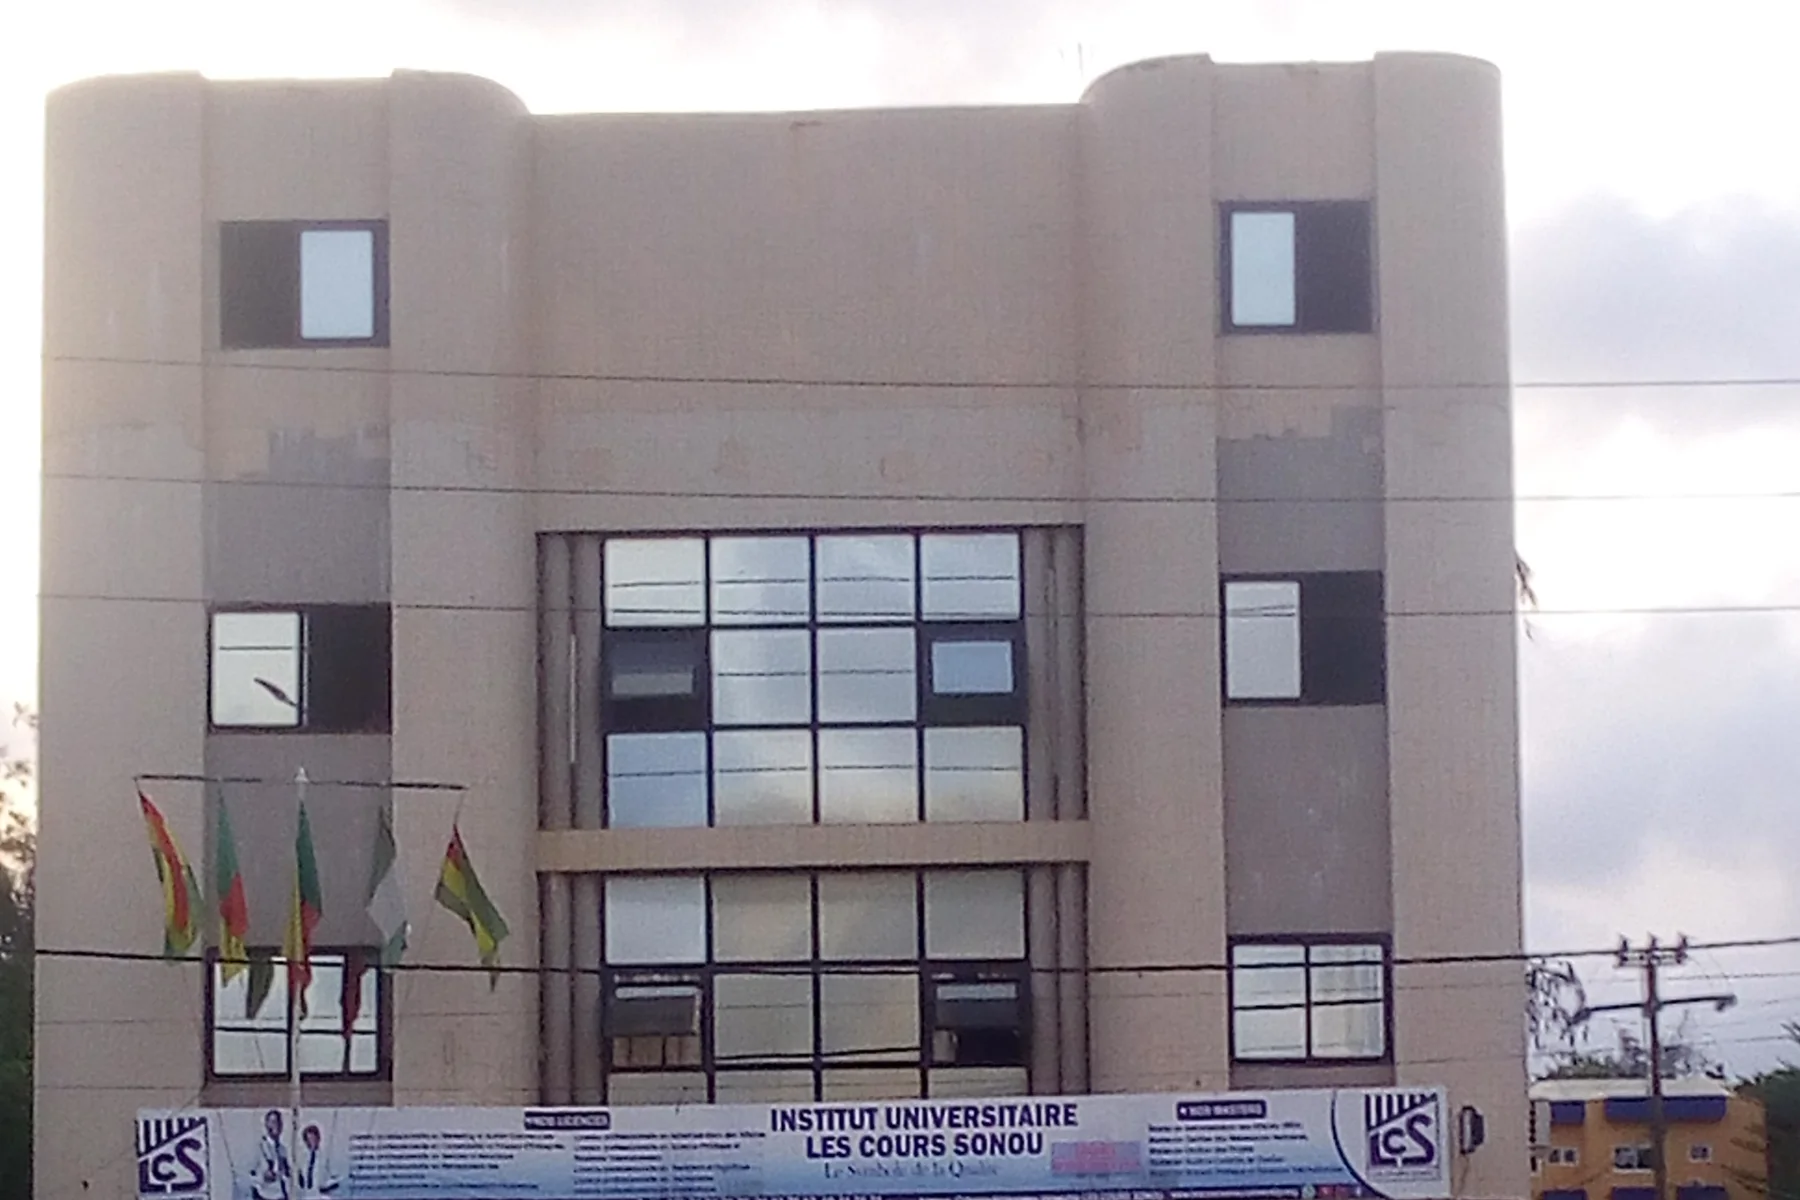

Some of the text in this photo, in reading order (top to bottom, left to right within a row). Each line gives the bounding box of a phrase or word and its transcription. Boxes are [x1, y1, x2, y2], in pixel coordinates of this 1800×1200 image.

[770, 1103, 1079, 1132] INSTITUT UNIVERSITAIRE
[806, 1131, 1044, 1159] LES COURS SONOU
